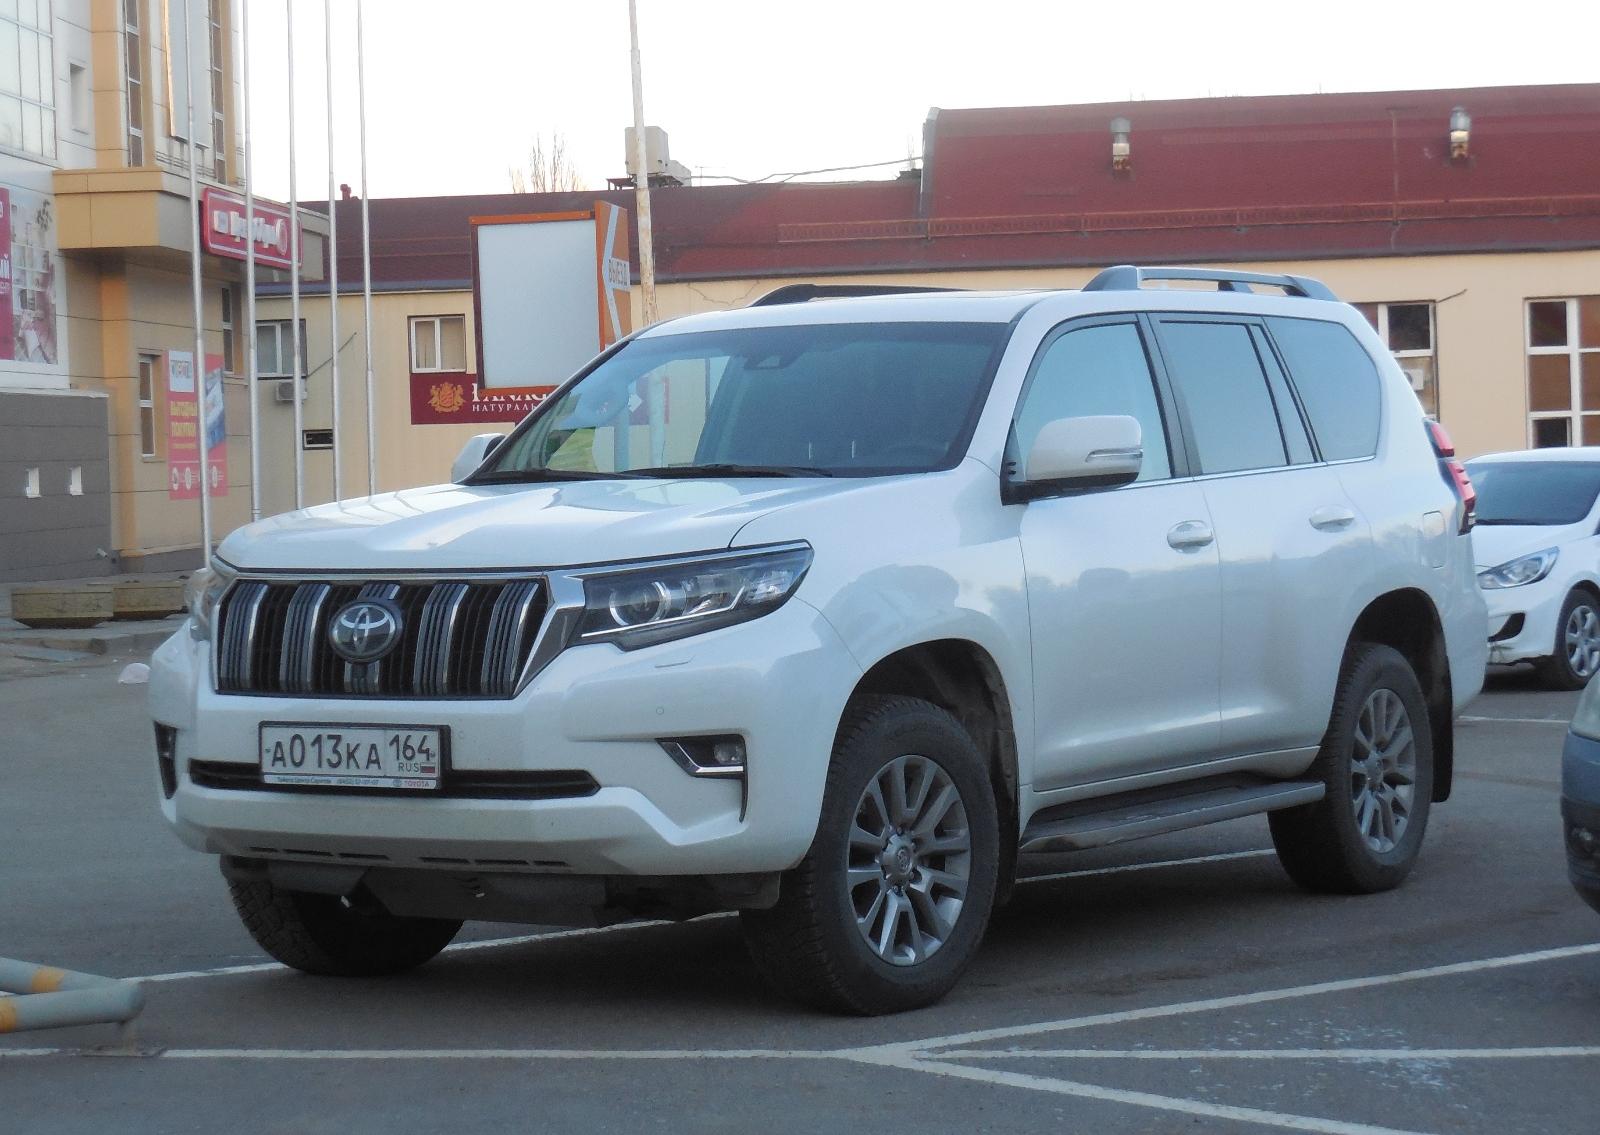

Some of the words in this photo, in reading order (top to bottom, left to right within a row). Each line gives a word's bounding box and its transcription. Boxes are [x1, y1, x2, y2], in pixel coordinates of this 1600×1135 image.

[271, 734, 382, 770] А013КА
[389, 734, 431, 761] 164
[399, 762, 420, 773] RUS
[404, 780, 430, 788] TOYOTA
